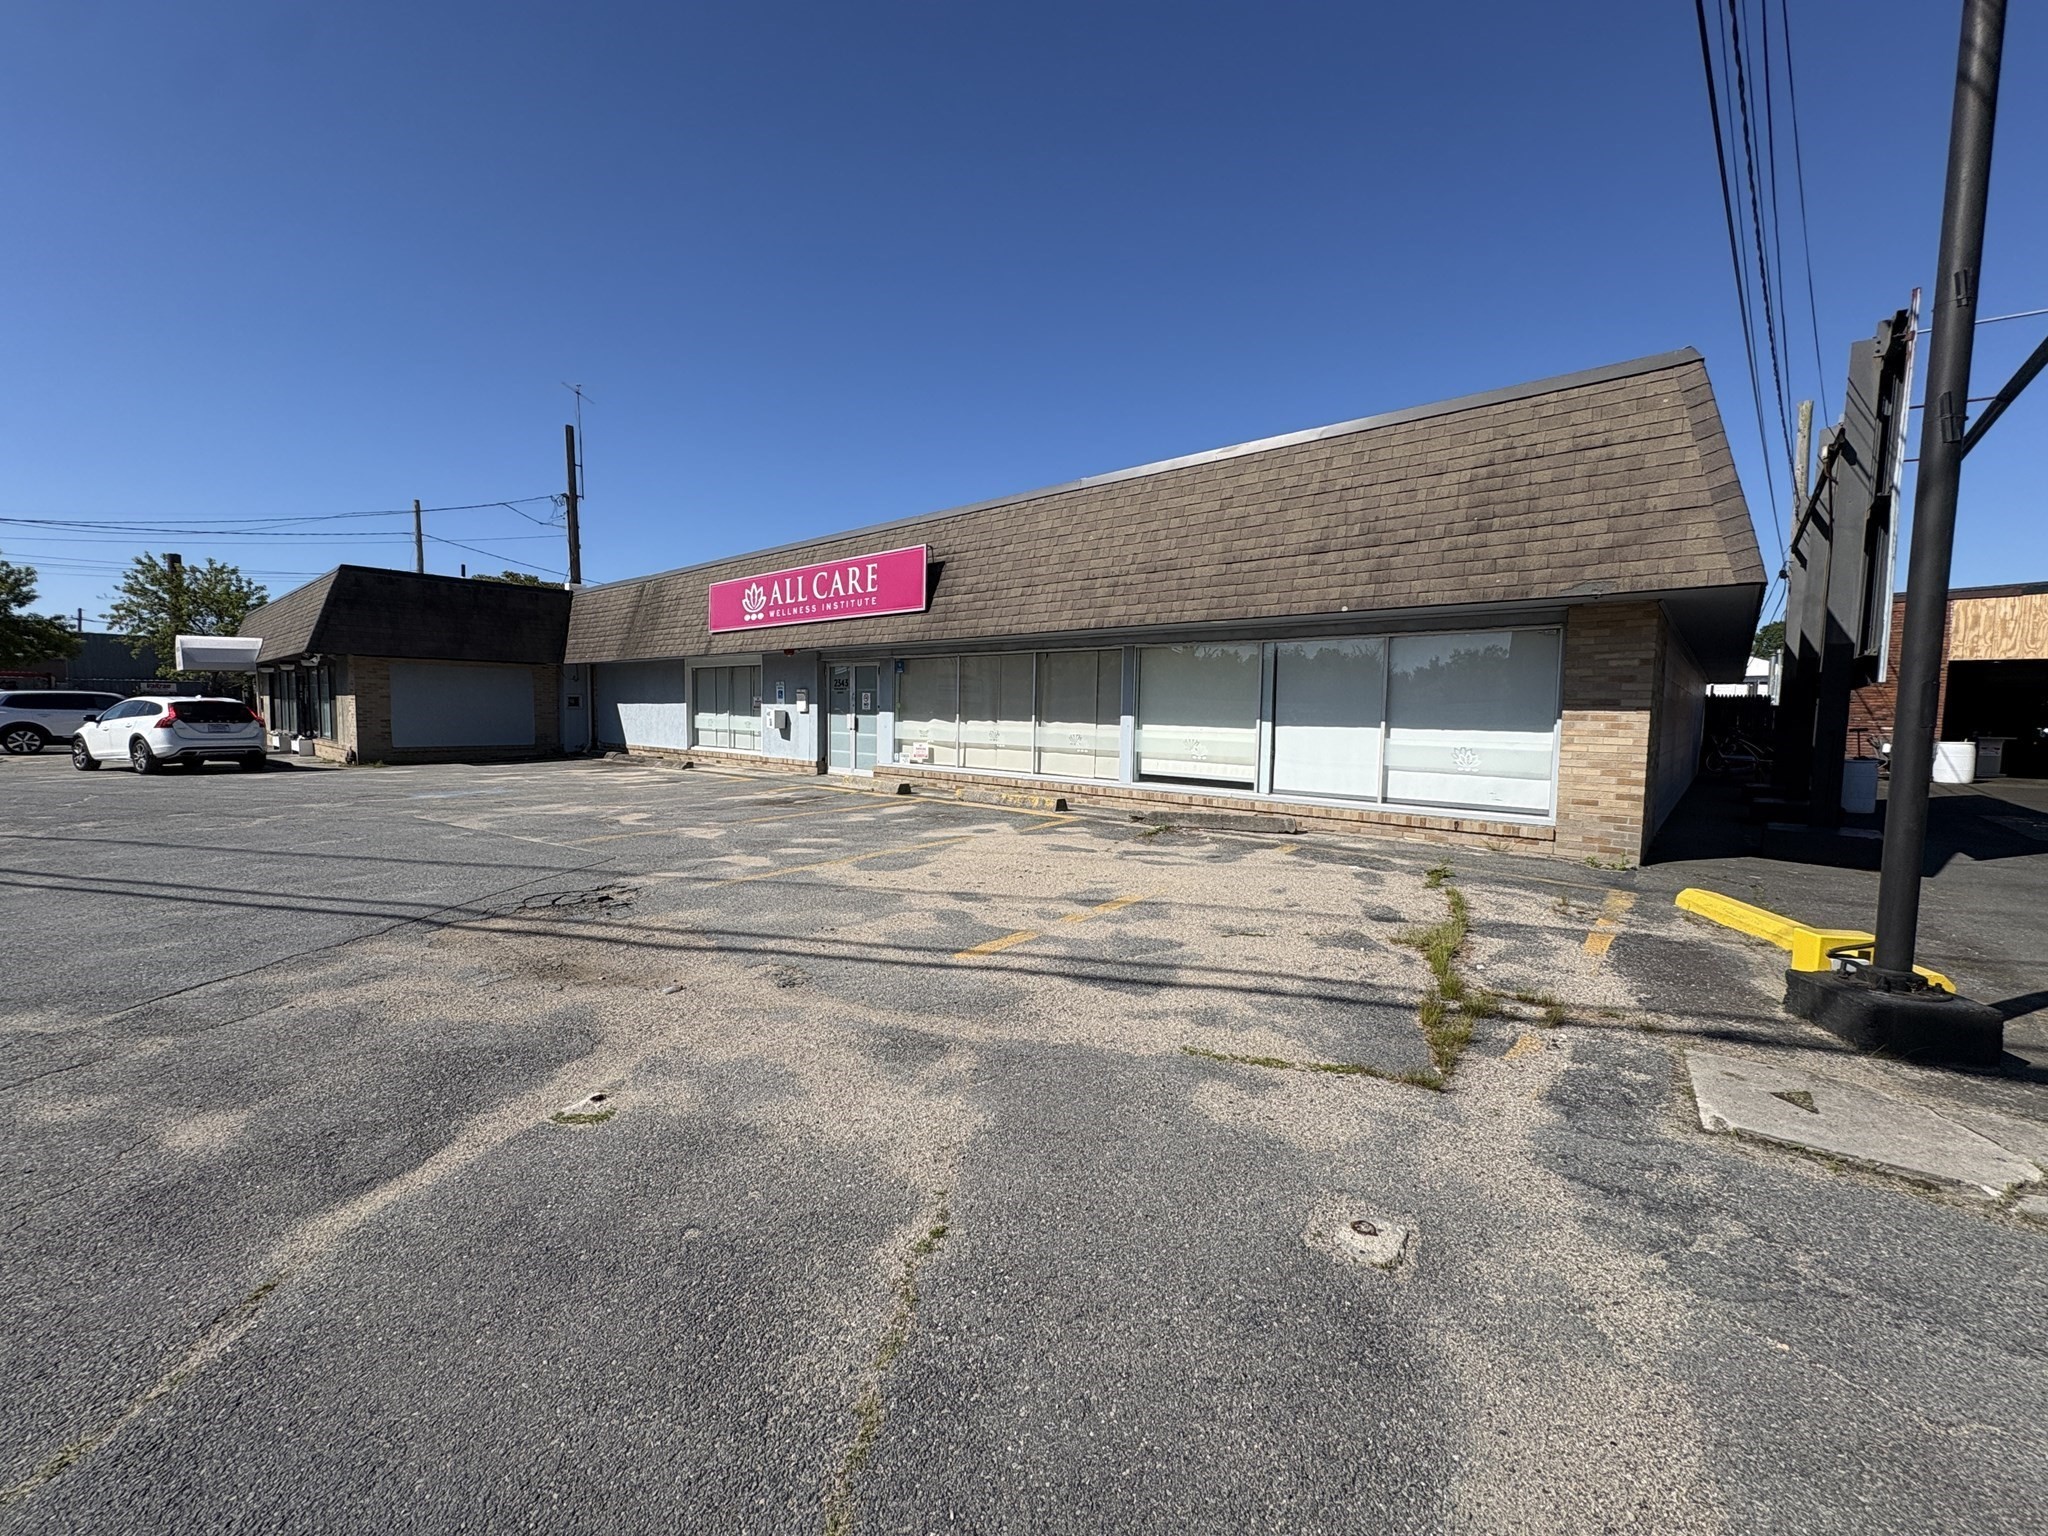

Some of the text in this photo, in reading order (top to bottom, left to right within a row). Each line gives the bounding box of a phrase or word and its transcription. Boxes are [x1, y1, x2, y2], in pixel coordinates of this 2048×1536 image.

[769, 563, 878, 606] ALL CARE
[769, 596, 877, 617] WELLNESS INSTITUTE
